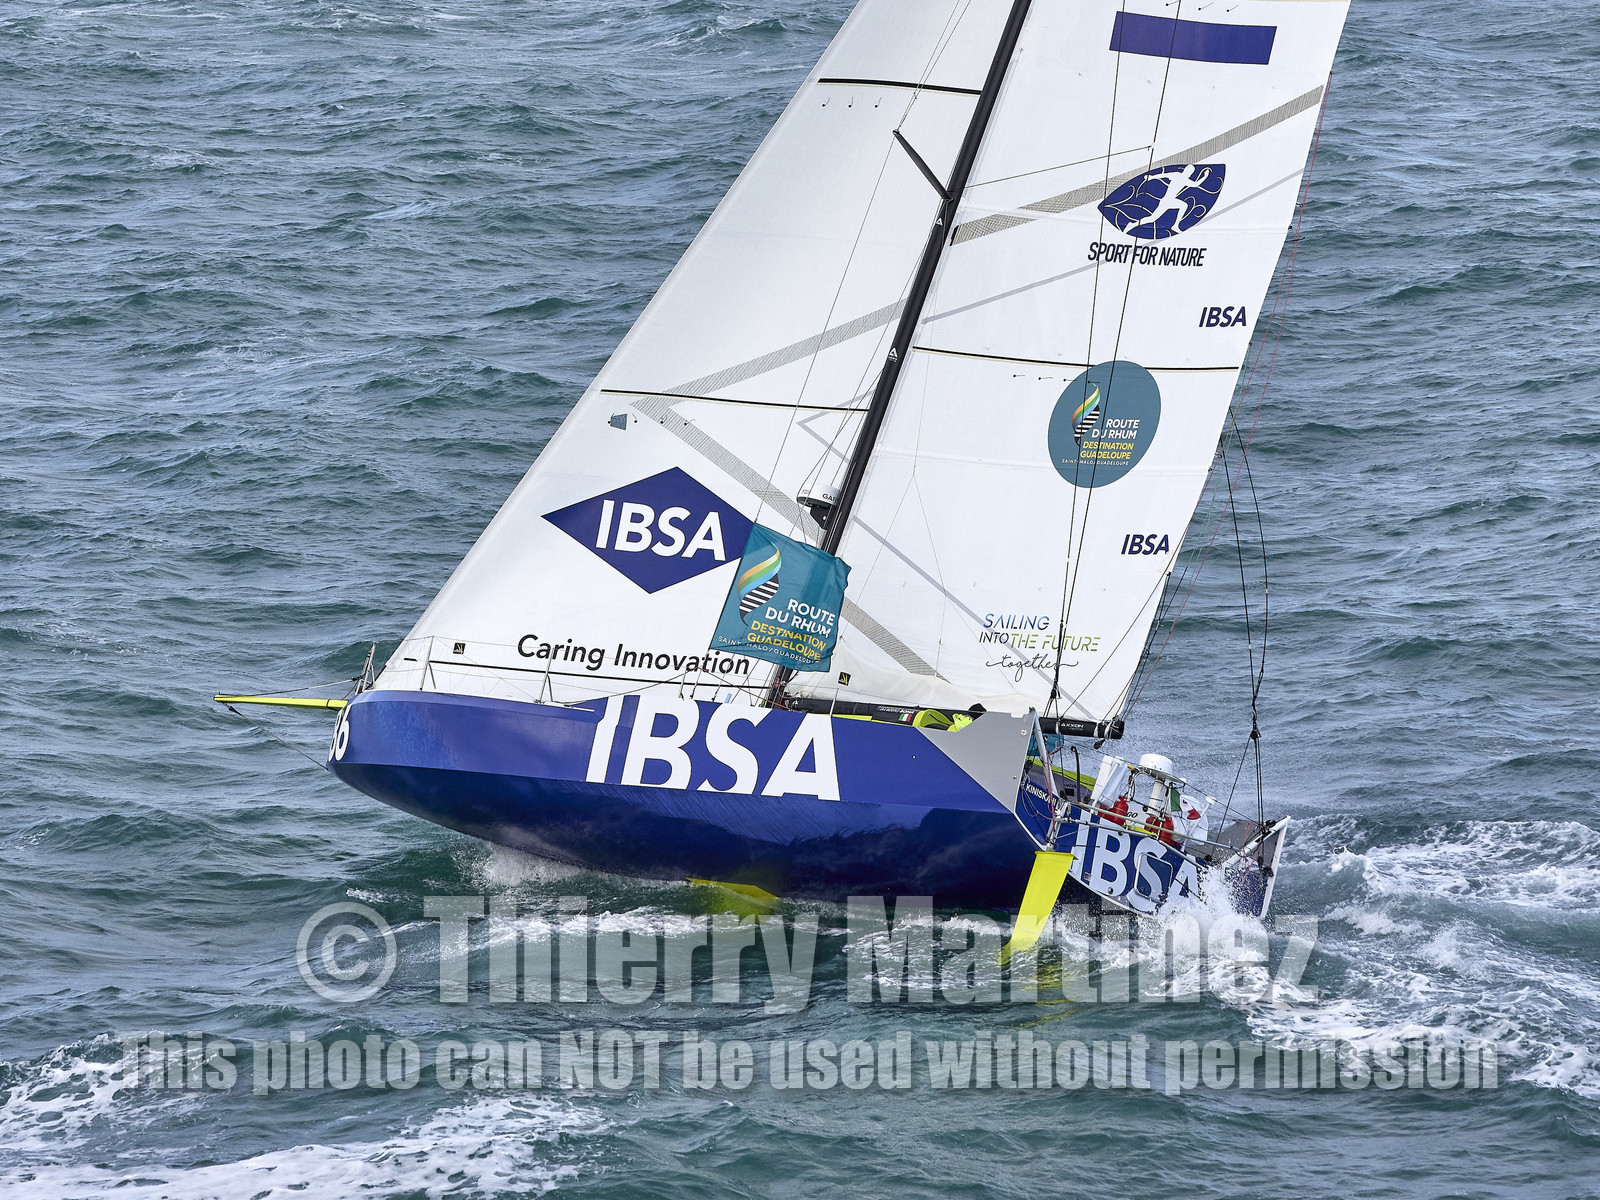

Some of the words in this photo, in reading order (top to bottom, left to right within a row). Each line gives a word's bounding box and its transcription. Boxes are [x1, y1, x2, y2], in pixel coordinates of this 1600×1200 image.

[1087, 241, 1132, 264] SPORT
[1131, 245, 1158, 266] FOR
[1158, 246, 1207, 267] NATURE
[1199, 306, 1247, 328] IBSA
[1091, 428, 1107, 439] DU
[1108, 429, 1137, 440] RHUM
[1105, 418, 1140, 429] ROUTE
[1080, 450, 1131, 460] GUADELOUPE
[1082, 441, 1134, 450] DESTINATION
[595, 498, 726, 561] IBSA
[1121, 533, 1169, 556] IBSA
[765, 606, 788, 623] DU
[791, 614, 831, 639] RHUM
[787, 598, 836, 626] ROUTE
[983, 613, 1050, 631] SAILING
[747, 632, 821, 661] GUADELOUPE
[751, 620, 826, 651] DESTINATION
[979, 631, 1009, 644] INTO
[1011, 633, 1039, 649] THE
[1042, 634, 1101, 652] FUTURE
[517, 634, 606, 671] Caring
[614, 643, 750, 675] Innovation
[986, 653, 1079, 682] together
[586, 695, 840, 801] IBSA
[1067, 809, 1203, 914] IBSA
